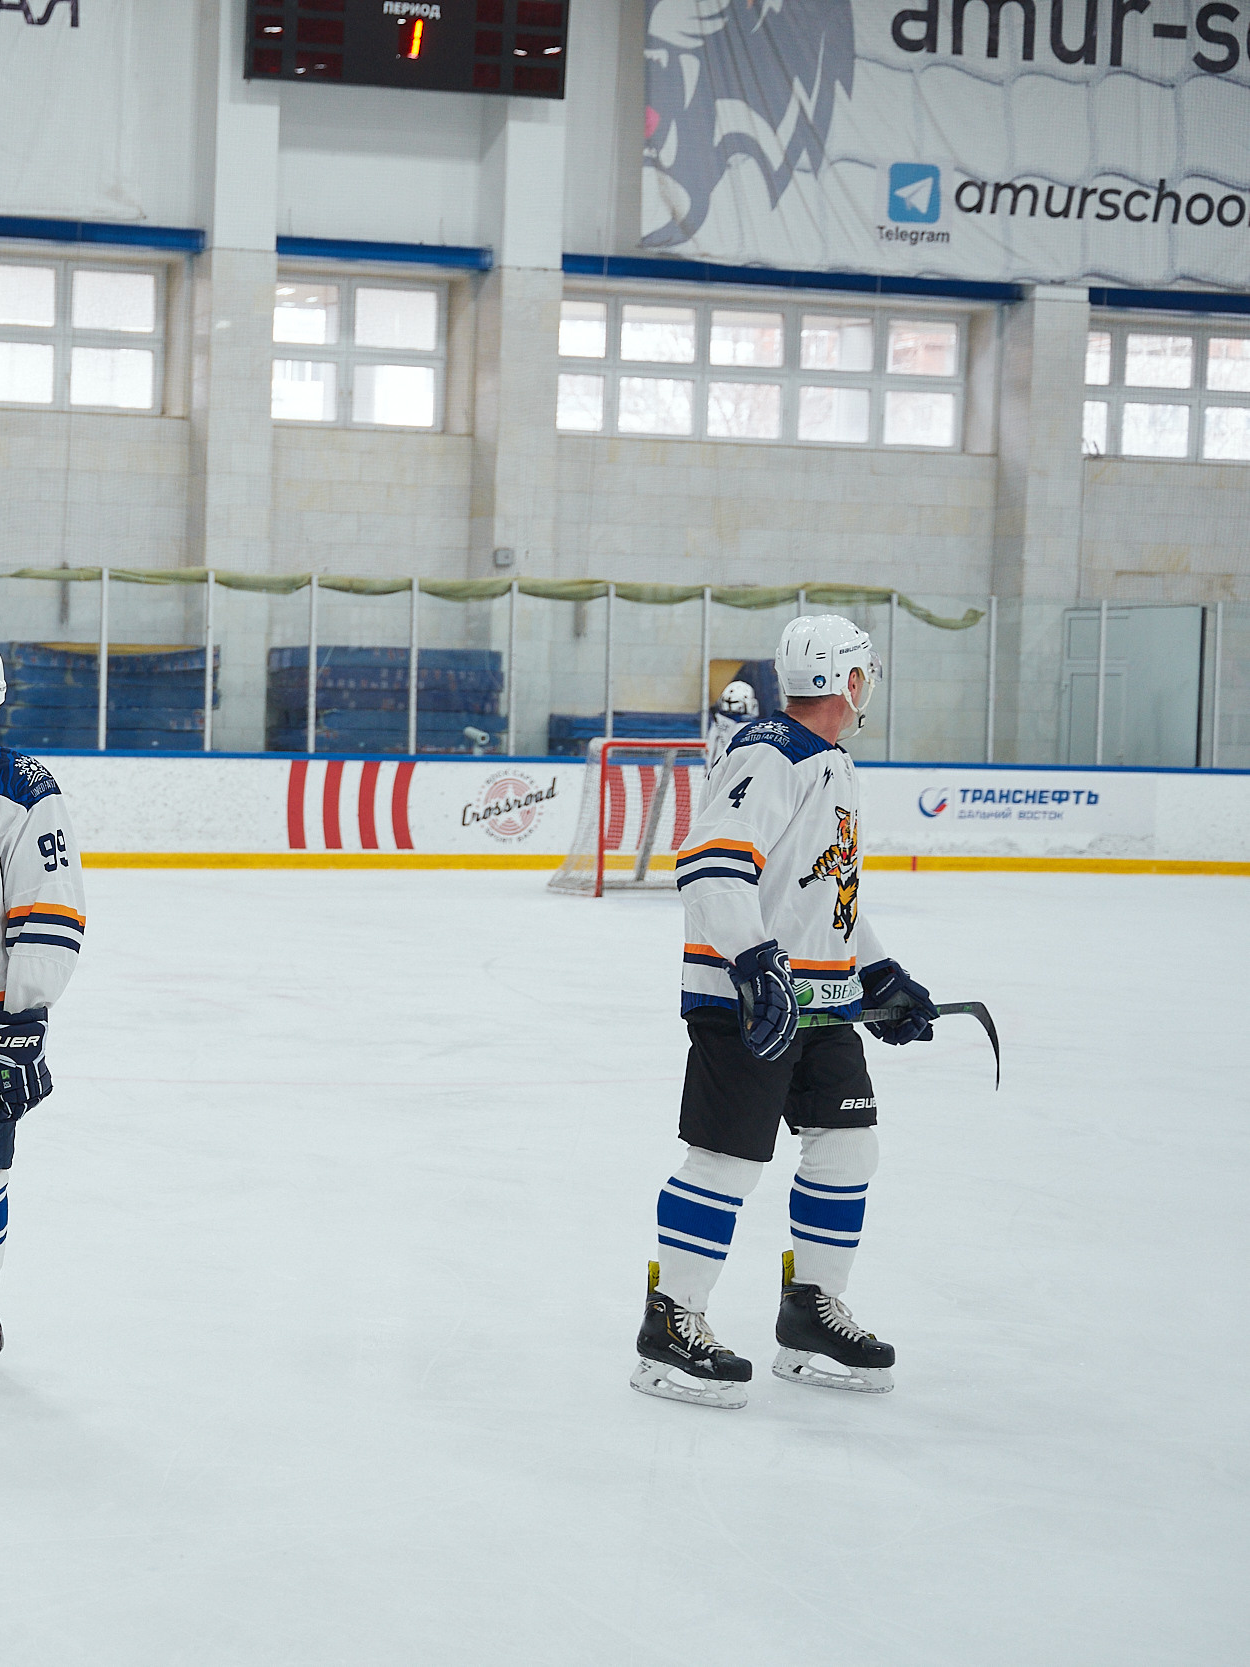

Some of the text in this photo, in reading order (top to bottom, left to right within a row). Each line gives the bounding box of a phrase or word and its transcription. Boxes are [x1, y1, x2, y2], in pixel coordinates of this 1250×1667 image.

[383, 1, 441, 20] ПЕРИОД
[406, 18, 424, 59] 1
[891, 0, 1250, 74] amur-s
[954, 178, 1250, 228] amurschoo
[877, 225, 951, 245] Telegram
[461, 776, 557, 827] Crossroad
[728, 776, 754, 809] 4
[959, 788, 1100, 806] ТРАНСНЕФТЬ
[1018, 811, 1064, 822] ВОСТОК
[37, 828, 69, 873] 99
